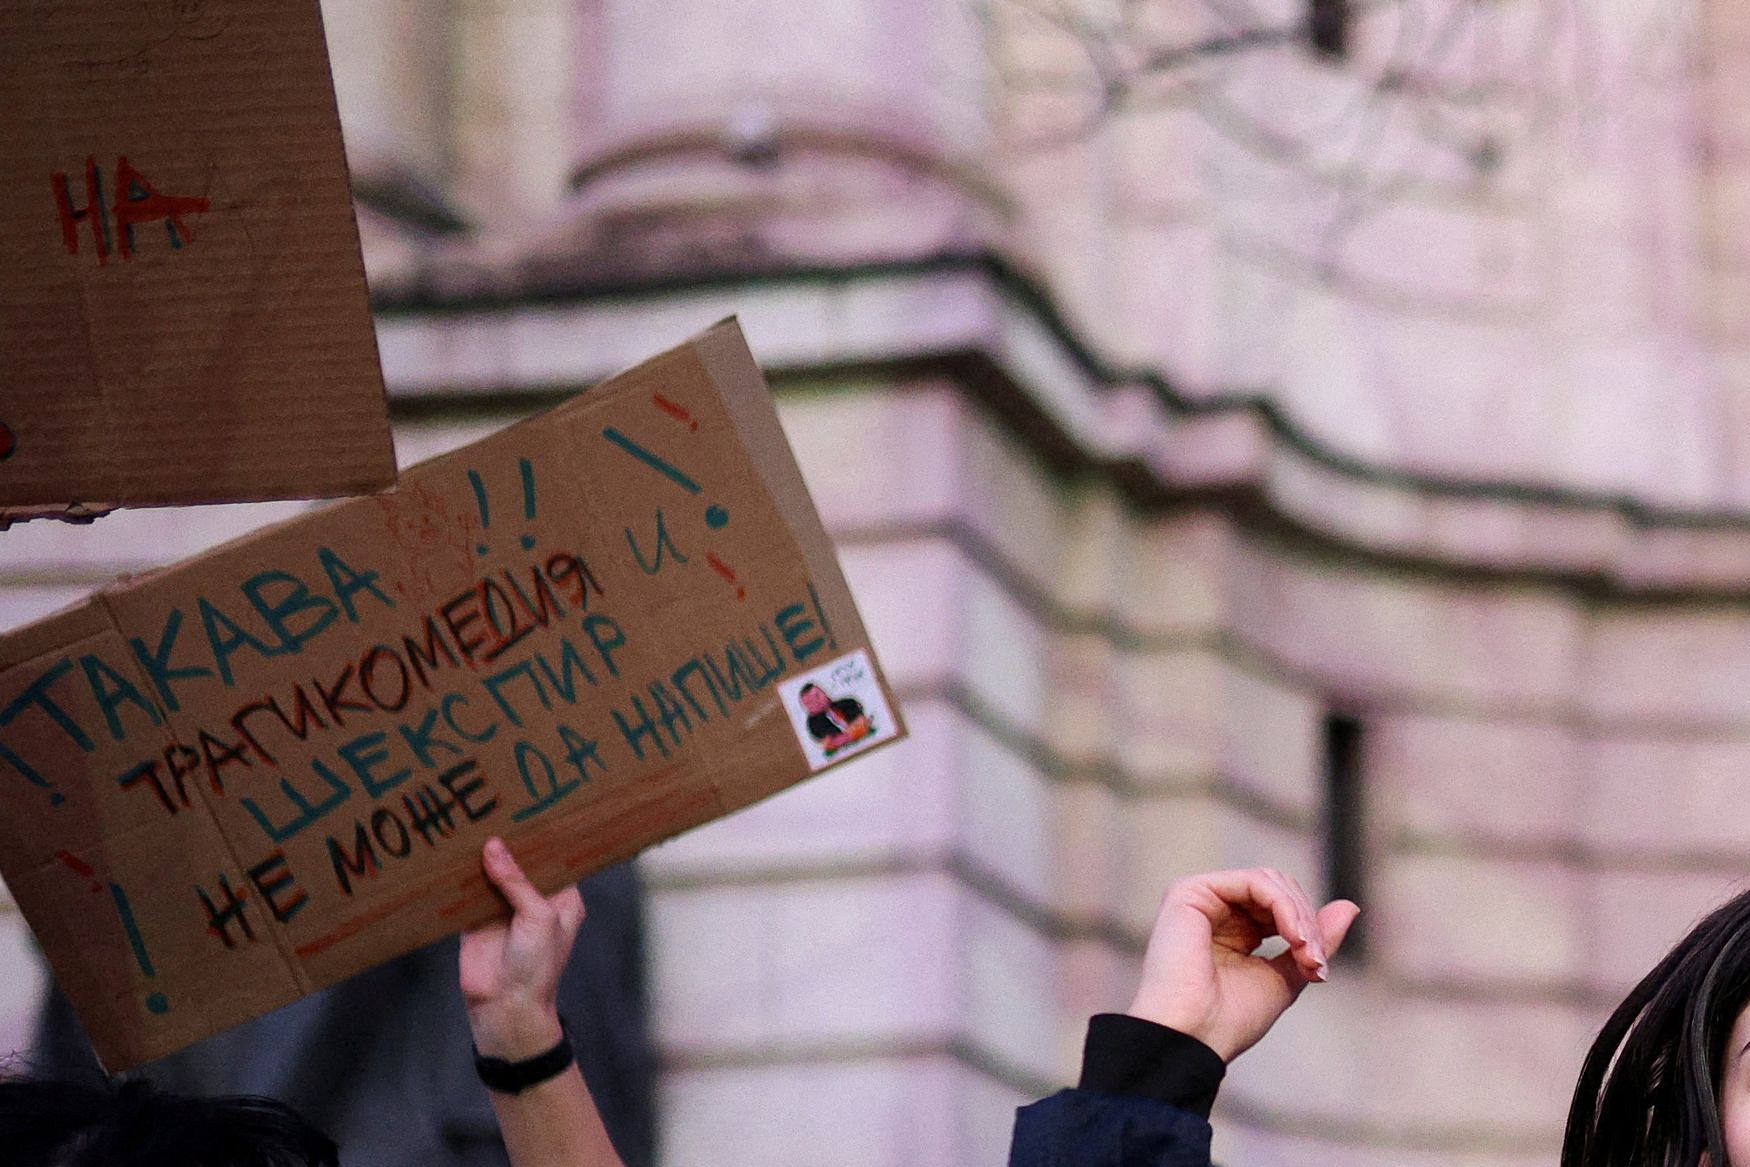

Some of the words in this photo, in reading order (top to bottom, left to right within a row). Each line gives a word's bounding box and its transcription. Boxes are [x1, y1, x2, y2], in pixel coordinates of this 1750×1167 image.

[52, 155, 210, 266] НА
[0, 547, 395, 753] ТАКАВА
[118, 552, 604, 815] ТРАГИКОМЕДИЯ
[624, 509, 687, 576] И
[200, 848, 310, 948] НЕ
[326, 760, 498, 895] МОЖЕ
[514, 728, 605, 823] ДА
[610, 578, 840, 762] НАПИШЕ!
[240, 612, 626, 843] ШЕКСПИР
